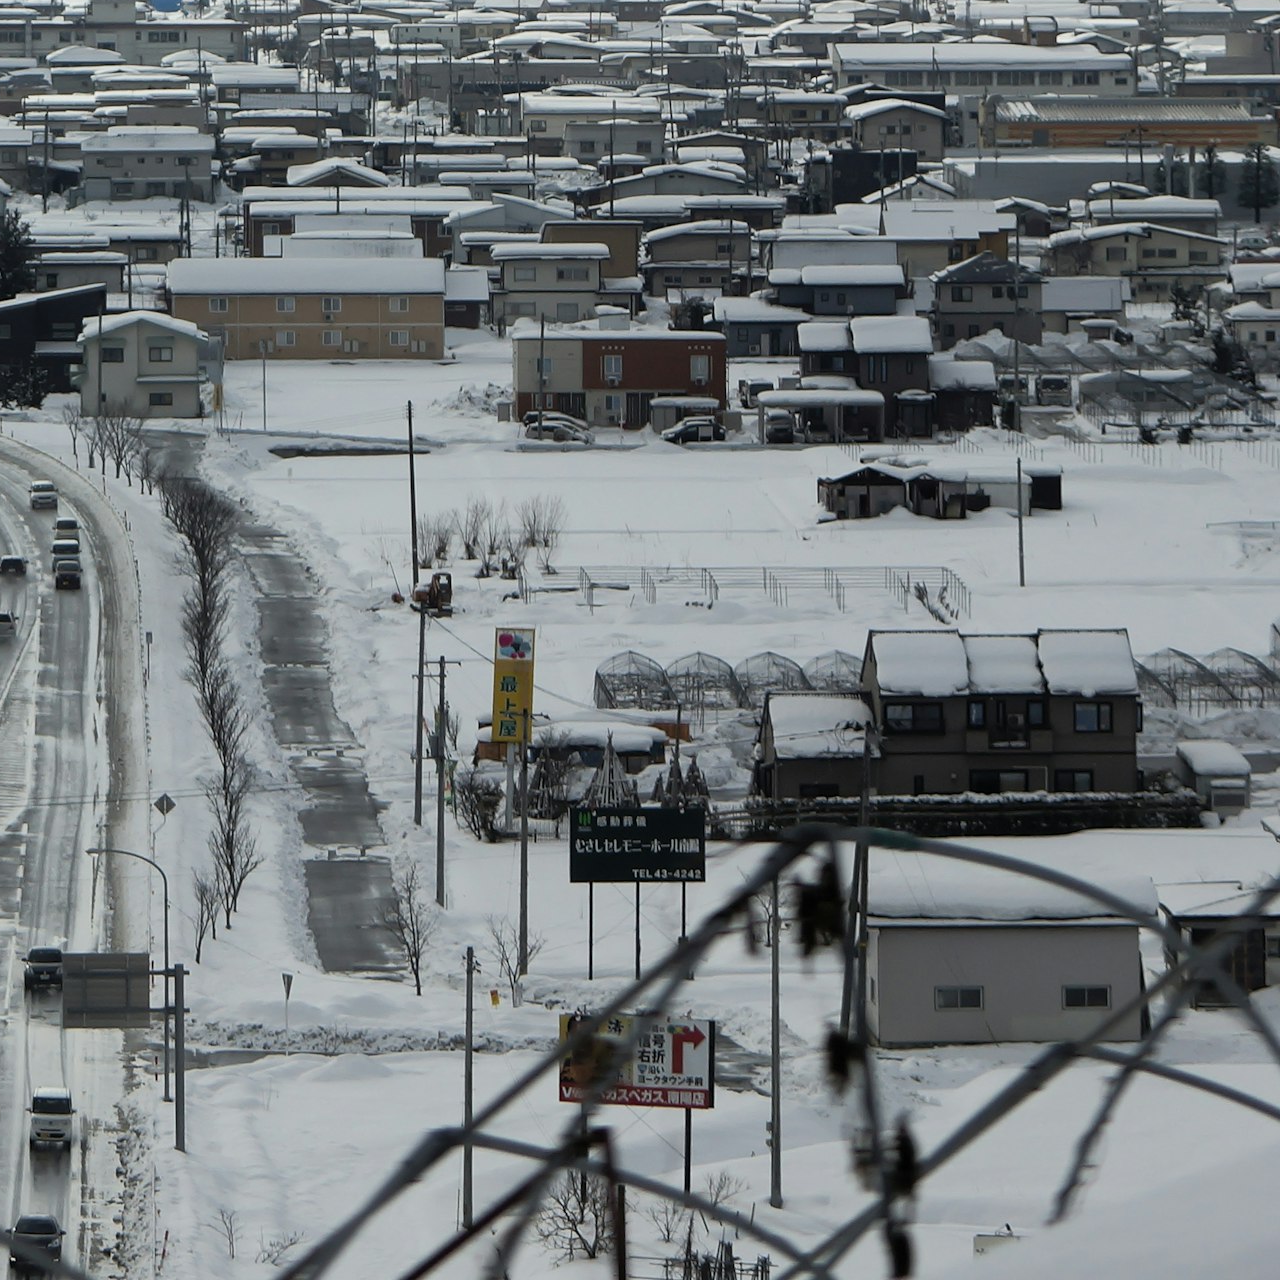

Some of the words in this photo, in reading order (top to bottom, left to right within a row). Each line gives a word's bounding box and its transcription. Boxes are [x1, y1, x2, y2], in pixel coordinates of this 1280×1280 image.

[498, 676, 517, 737] 最上屋
[596, 815, 647, 828] 感動葬儀
[632, 869, 652, 879] TEL
[653, 869, 703, 879] 43-4242
[637, 1049, 666, 1064] 右折
[637, 1074, 704, 1088] ヨークタウン手前
